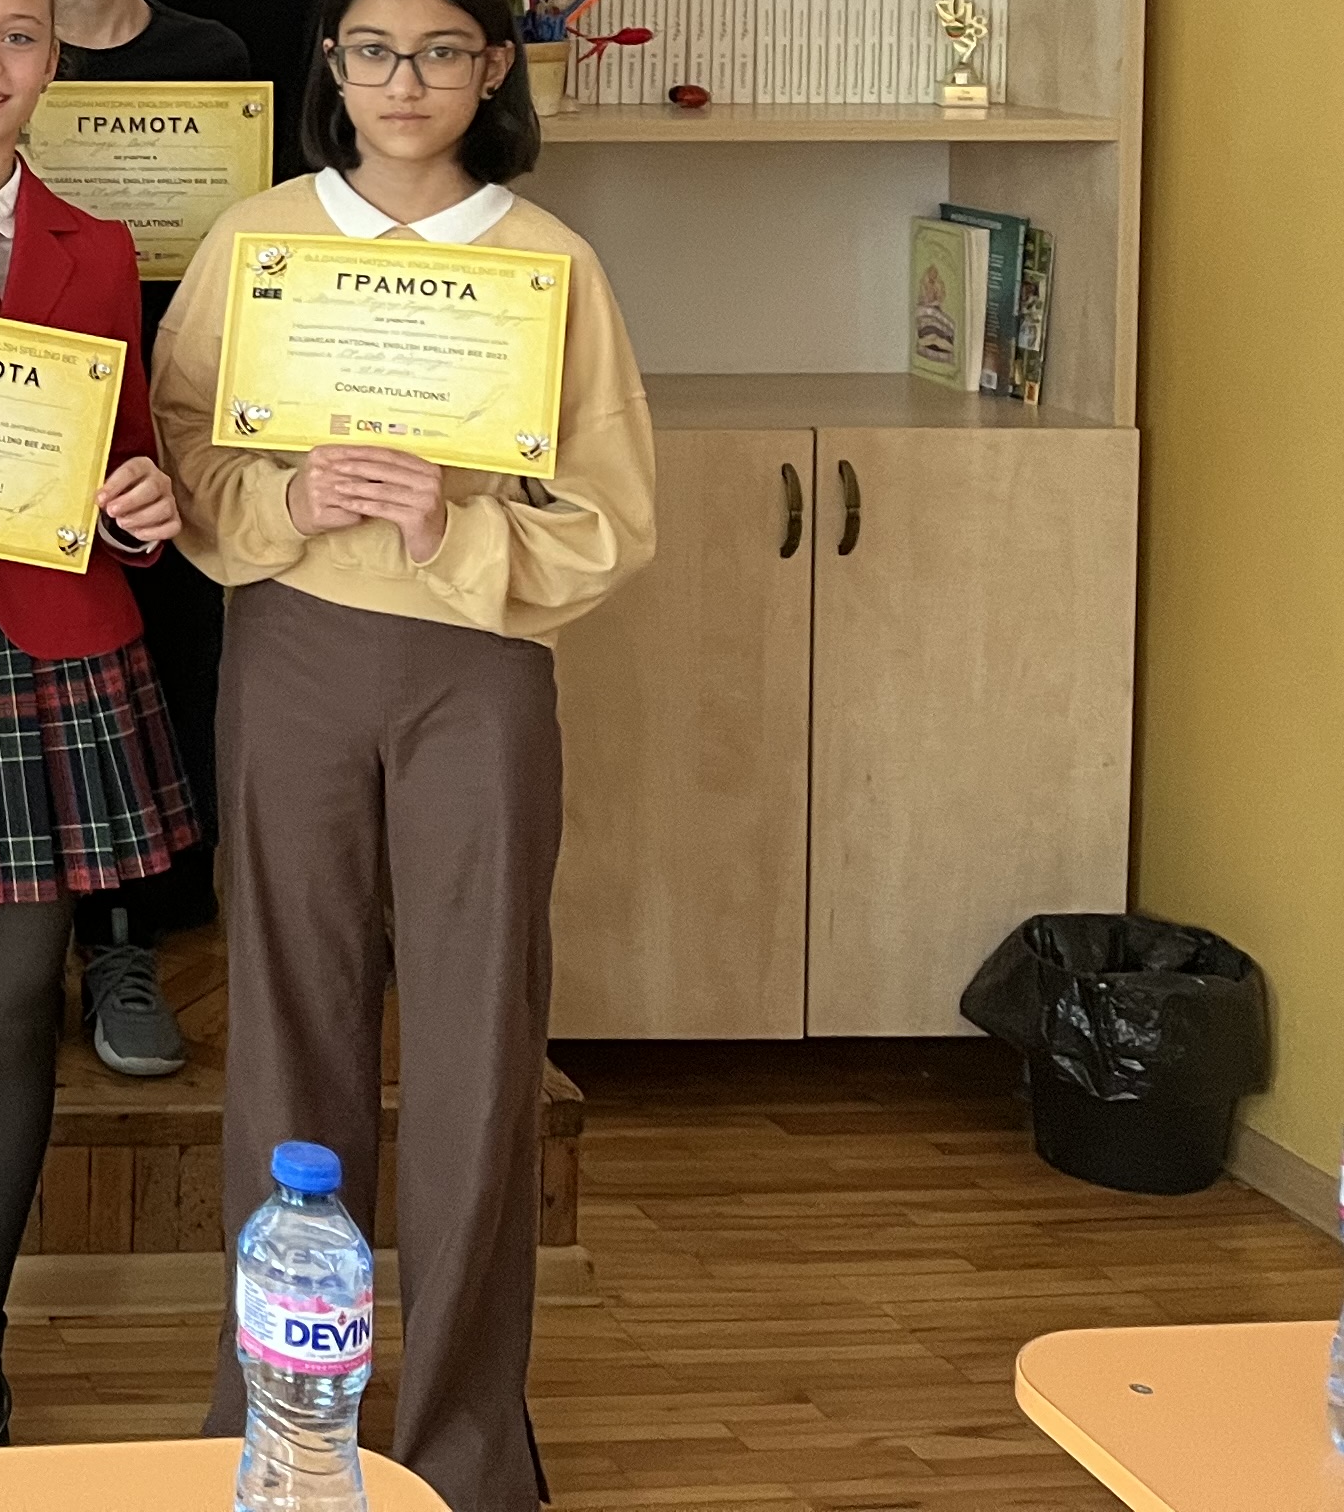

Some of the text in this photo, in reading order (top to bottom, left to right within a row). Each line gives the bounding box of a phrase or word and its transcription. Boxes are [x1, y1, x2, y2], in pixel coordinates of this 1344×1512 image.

[77, 117, 200, 134] ГРАМОТА
[124, 218, 183, 228] TULATIONS!
[336, 273, 478, 301] ГРАМОТА
[335, 381, 450, 403] CONGRATULATIONS!
[285, 1311, 371, 1352] DEVIN
